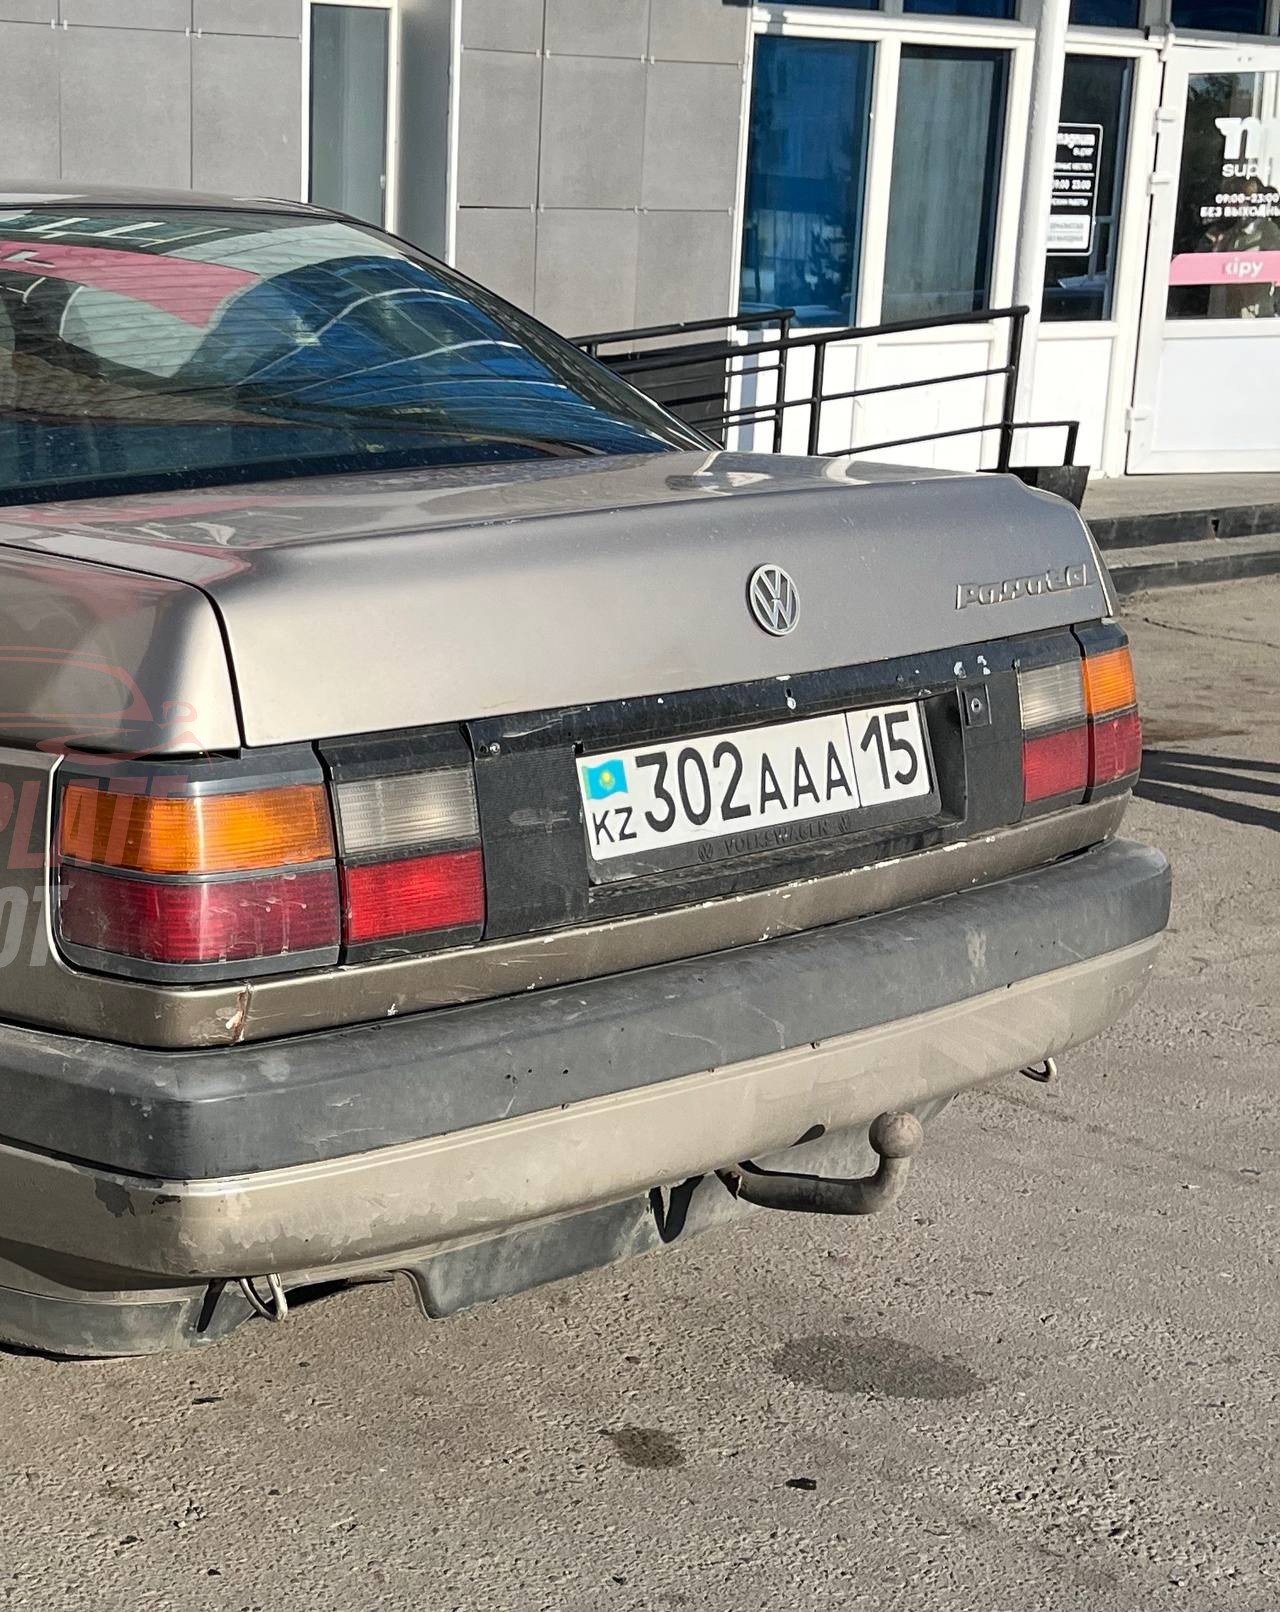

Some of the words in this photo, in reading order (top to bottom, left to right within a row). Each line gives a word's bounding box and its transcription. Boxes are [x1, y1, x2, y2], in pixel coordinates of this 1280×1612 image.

[1200, 206, 1222, 218] БЕЗ
[634, 740, 853, 833] 302AAA
[860, 710, 919, 790] 15
[592, 806, 638, 845] KZ
